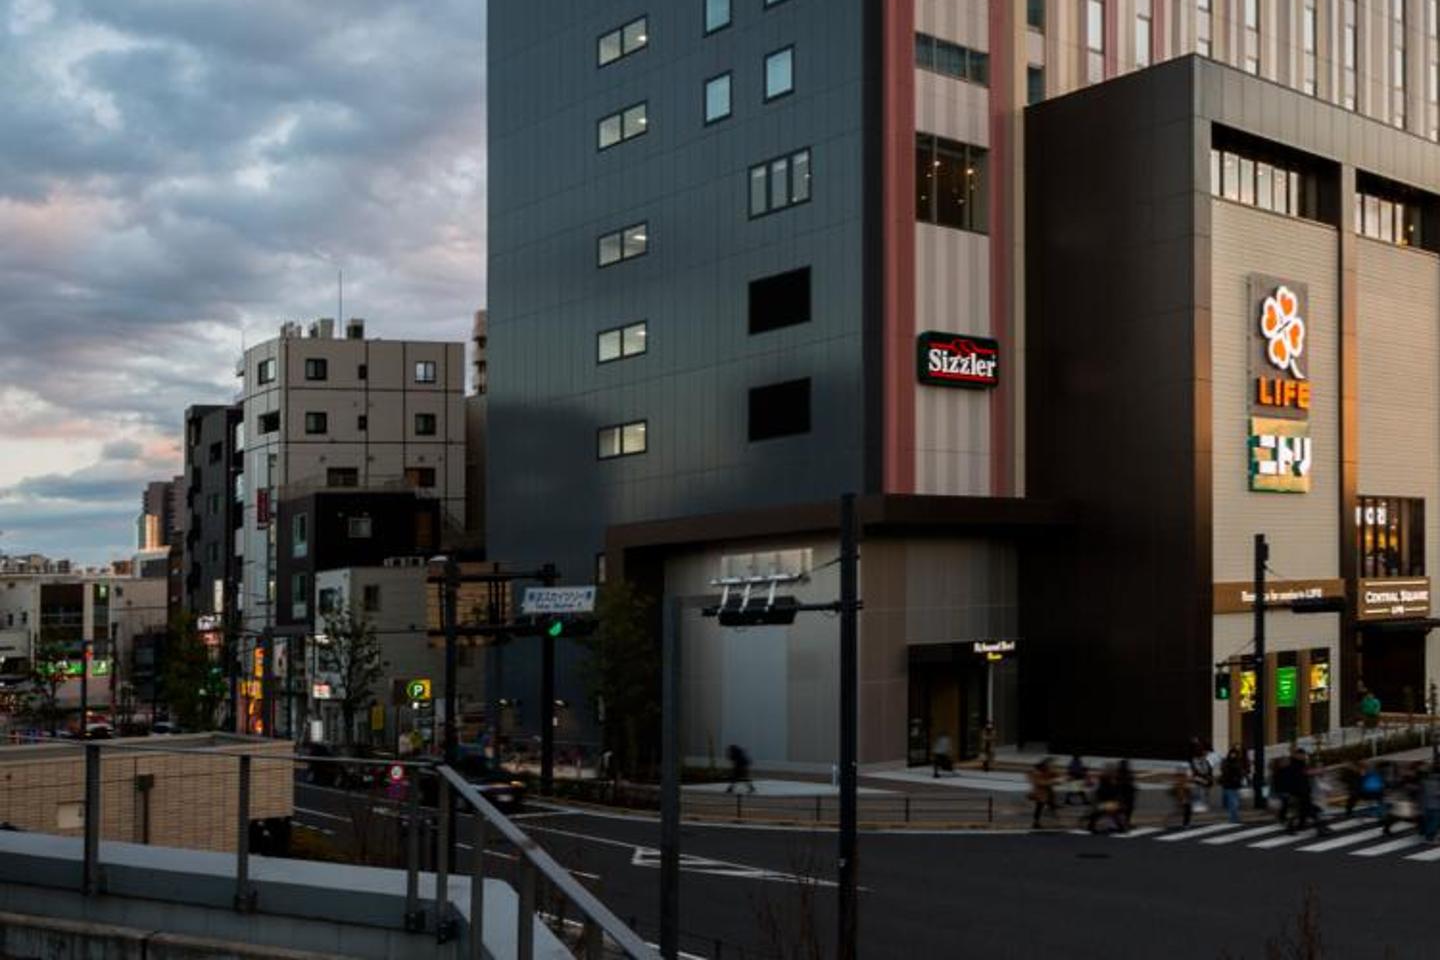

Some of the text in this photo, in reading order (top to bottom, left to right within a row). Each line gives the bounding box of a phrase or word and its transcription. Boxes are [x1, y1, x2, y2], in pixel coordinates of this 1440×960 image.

[928, 348, 996, 377] Sizzler
[1258, 375, 1311, 408] LIFE
[413, 684, 423, 696] P
